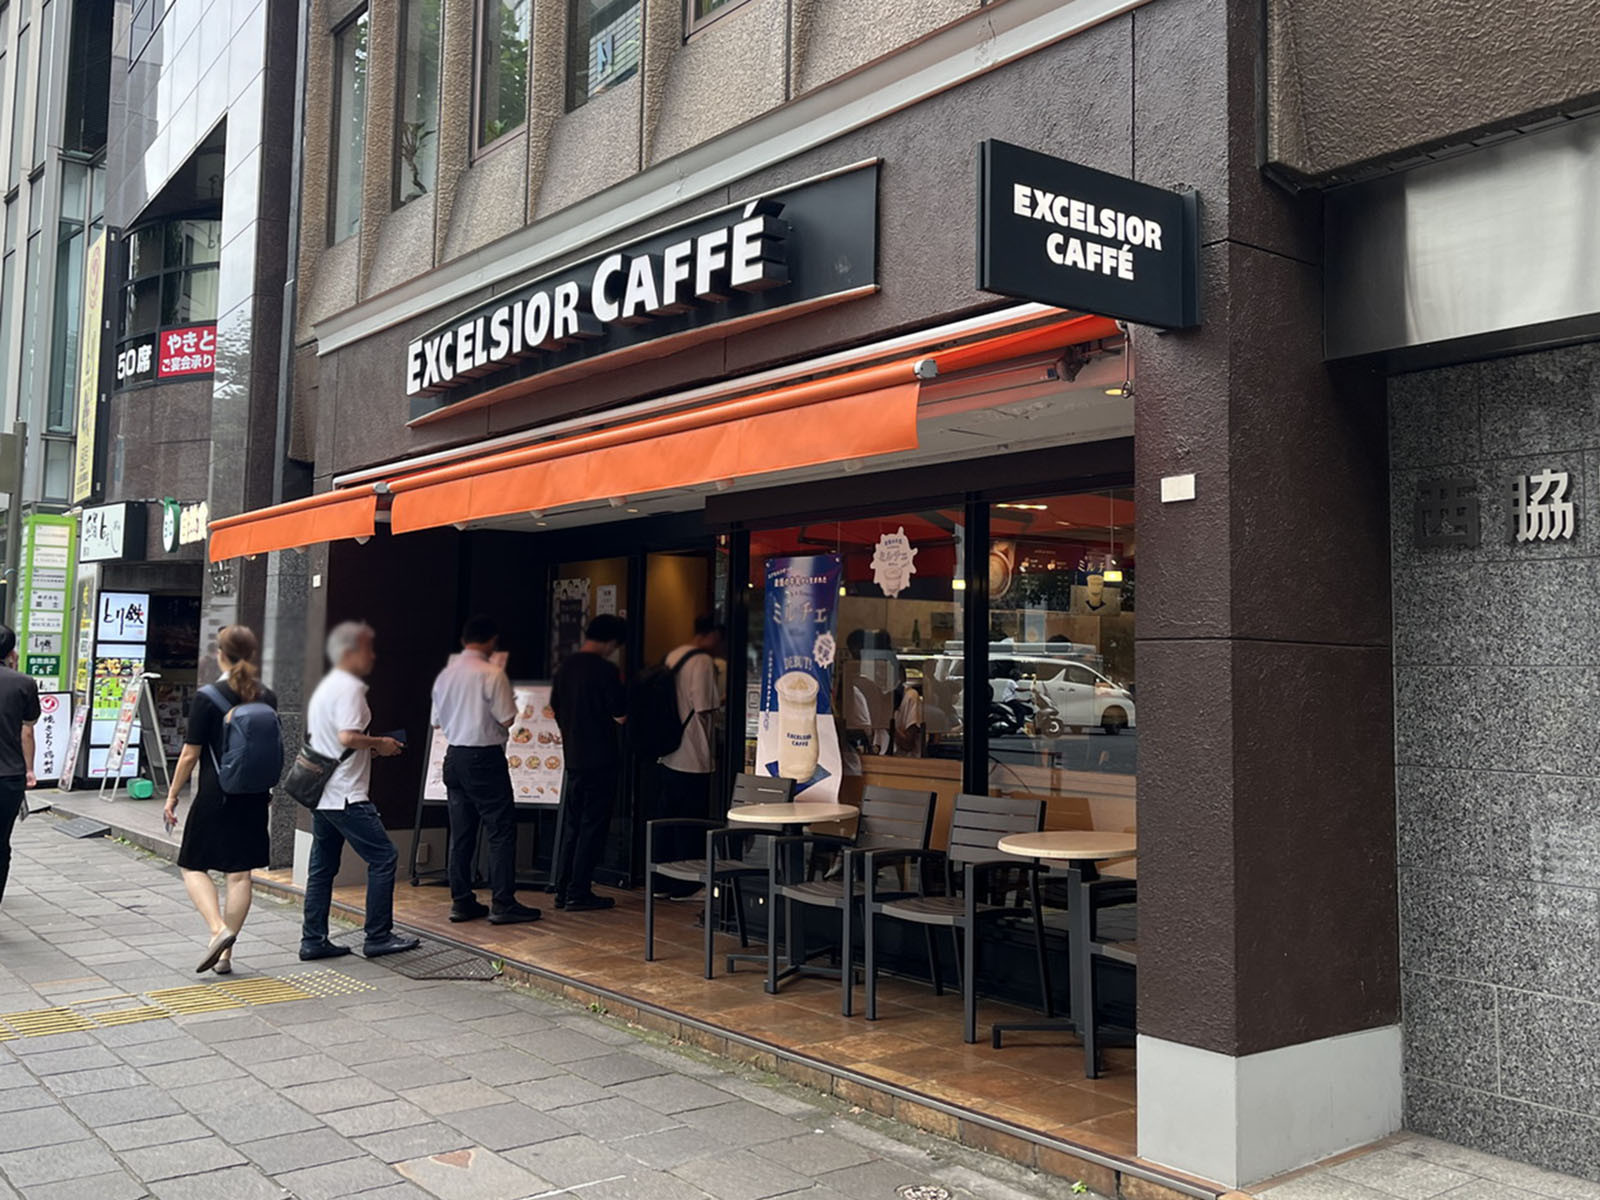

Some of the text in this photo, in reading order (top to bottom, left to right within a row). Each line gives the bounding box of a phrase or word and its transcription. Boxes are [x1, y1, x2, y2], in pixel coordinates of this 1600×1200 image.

[1013, 183, 1163, 251] EXCELSIOR
[1046, 231, 1135, 281] CAFFÉ
[406, 199, 766, 397] EXCELSIOR CAFFÉ
[161, 354, 217, 372] ご宴会承り
